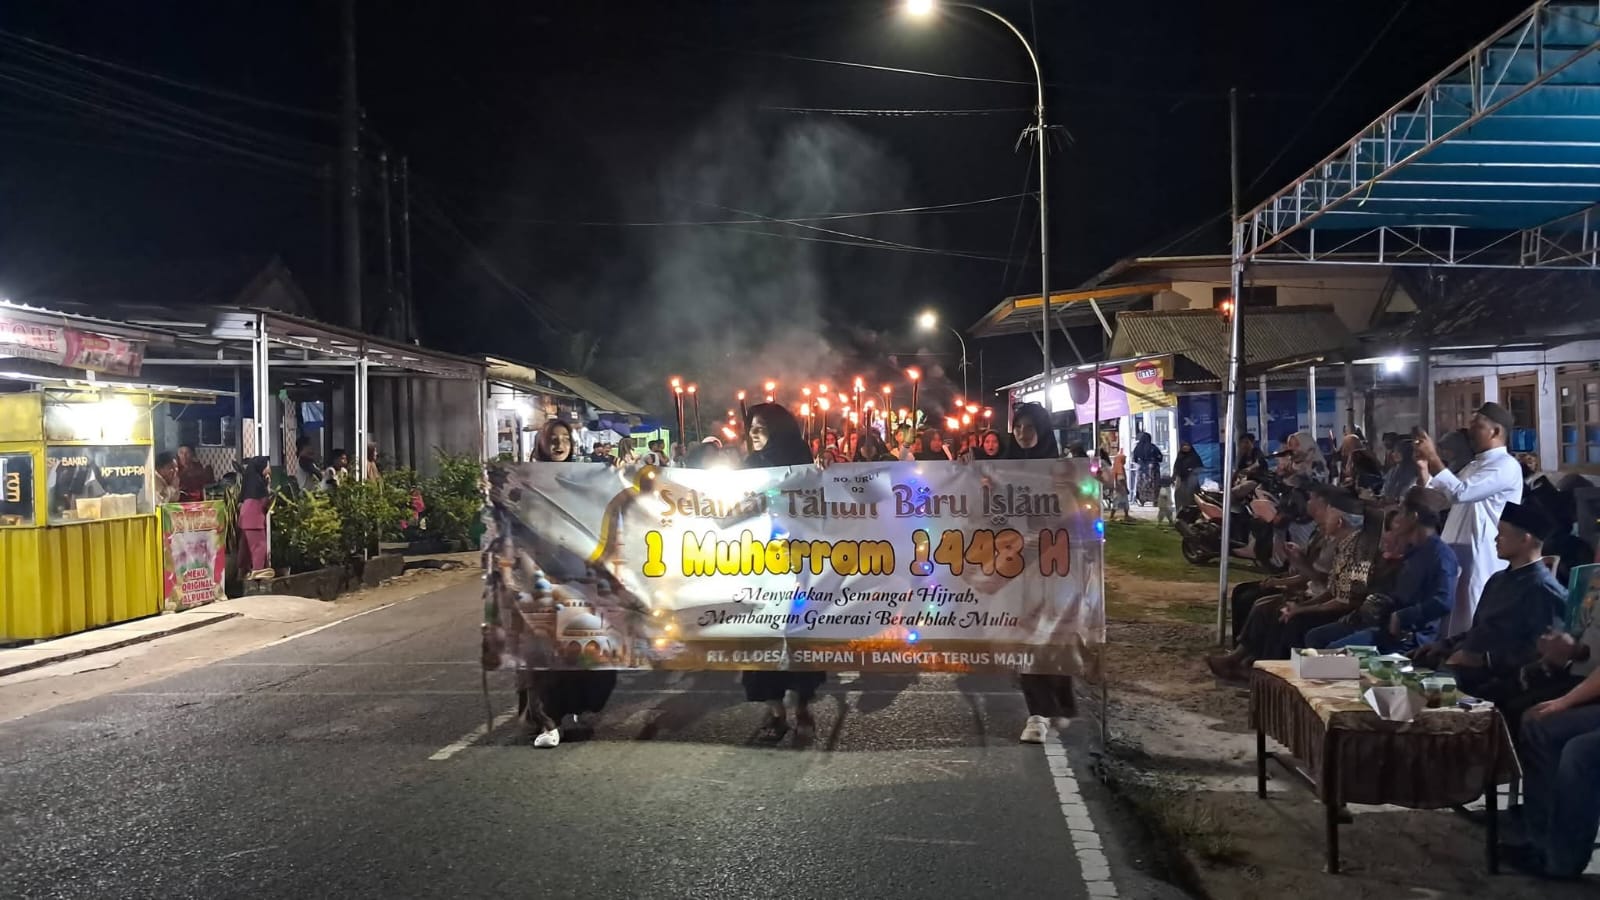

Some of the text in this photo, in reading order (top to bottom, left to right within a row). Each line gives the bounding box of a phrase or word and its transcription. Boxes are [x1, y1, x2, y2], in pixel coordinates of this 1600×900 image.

[101, 465, 147, 478] KETOPRA
[851, 486, 865, 494] 02
[892, 483, 968, 518] Baru
[981, 483, 1062, 525] Islam
[642, 528, 1071, 578] 1 Muharram 1448 H
[732, 586, 834, 606] Menyalakan
[834, 586, 914, 607] Semangat
[698, 609, 1018, 630] Membangun Generasi Berakhlak Mulia
[706, 650, 729, 662] RT.
[751, 650, 789, 664] DESA
[794, 650, 855, 664] SEMPAN
[871, 650, 938, 665] BANGKIT
[941, 651, 990, 665] TERUS
[994, 652, 1036, 667] MAJU
